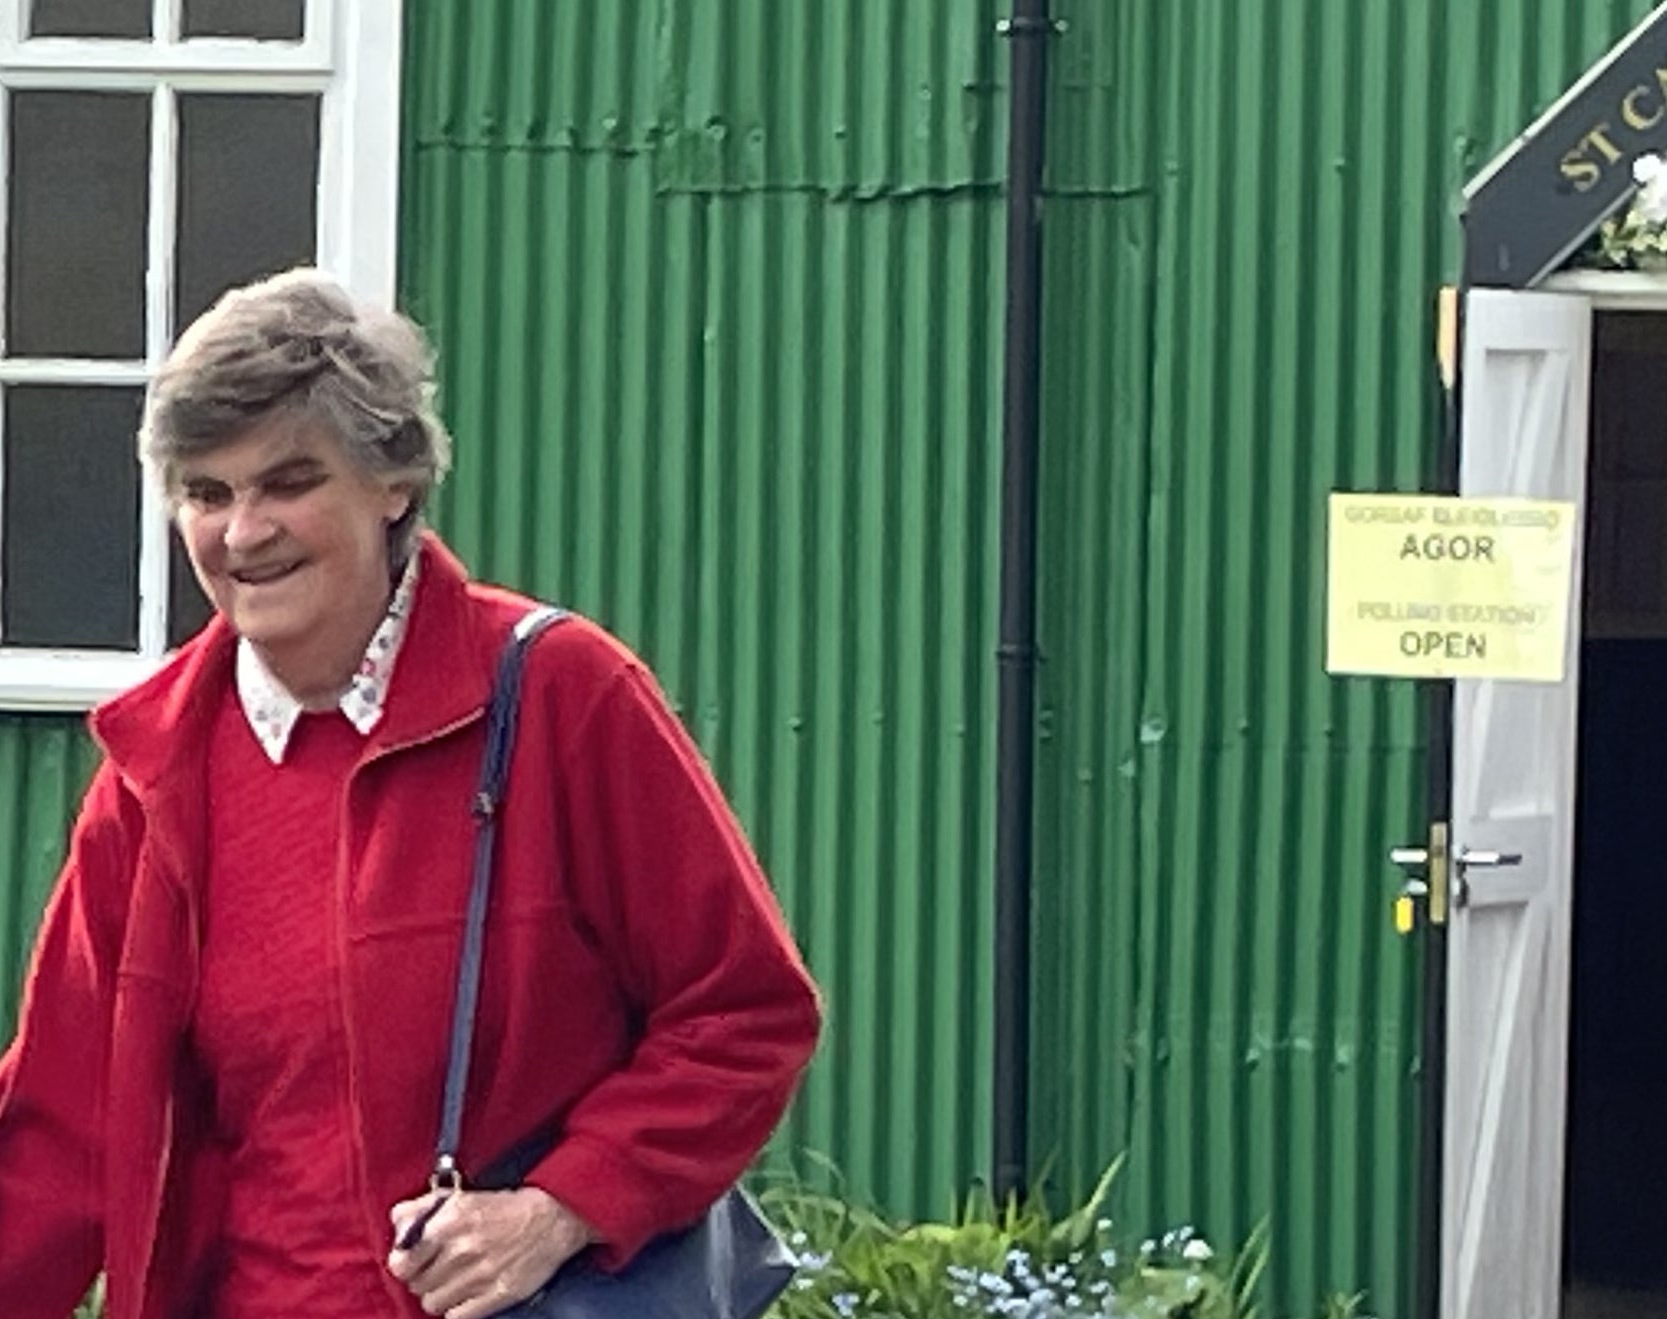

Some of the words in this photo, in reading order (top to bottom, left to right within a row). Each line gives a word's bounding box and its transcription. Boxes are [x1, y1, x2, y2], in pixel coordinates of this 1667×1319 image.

[1560, 122, 1623, 192] ST
[1399, 533, 1496, 562] AGOR
[1446, 602, 1536, 624] STATION
[1399, 631, 1487, 659] OPEN
